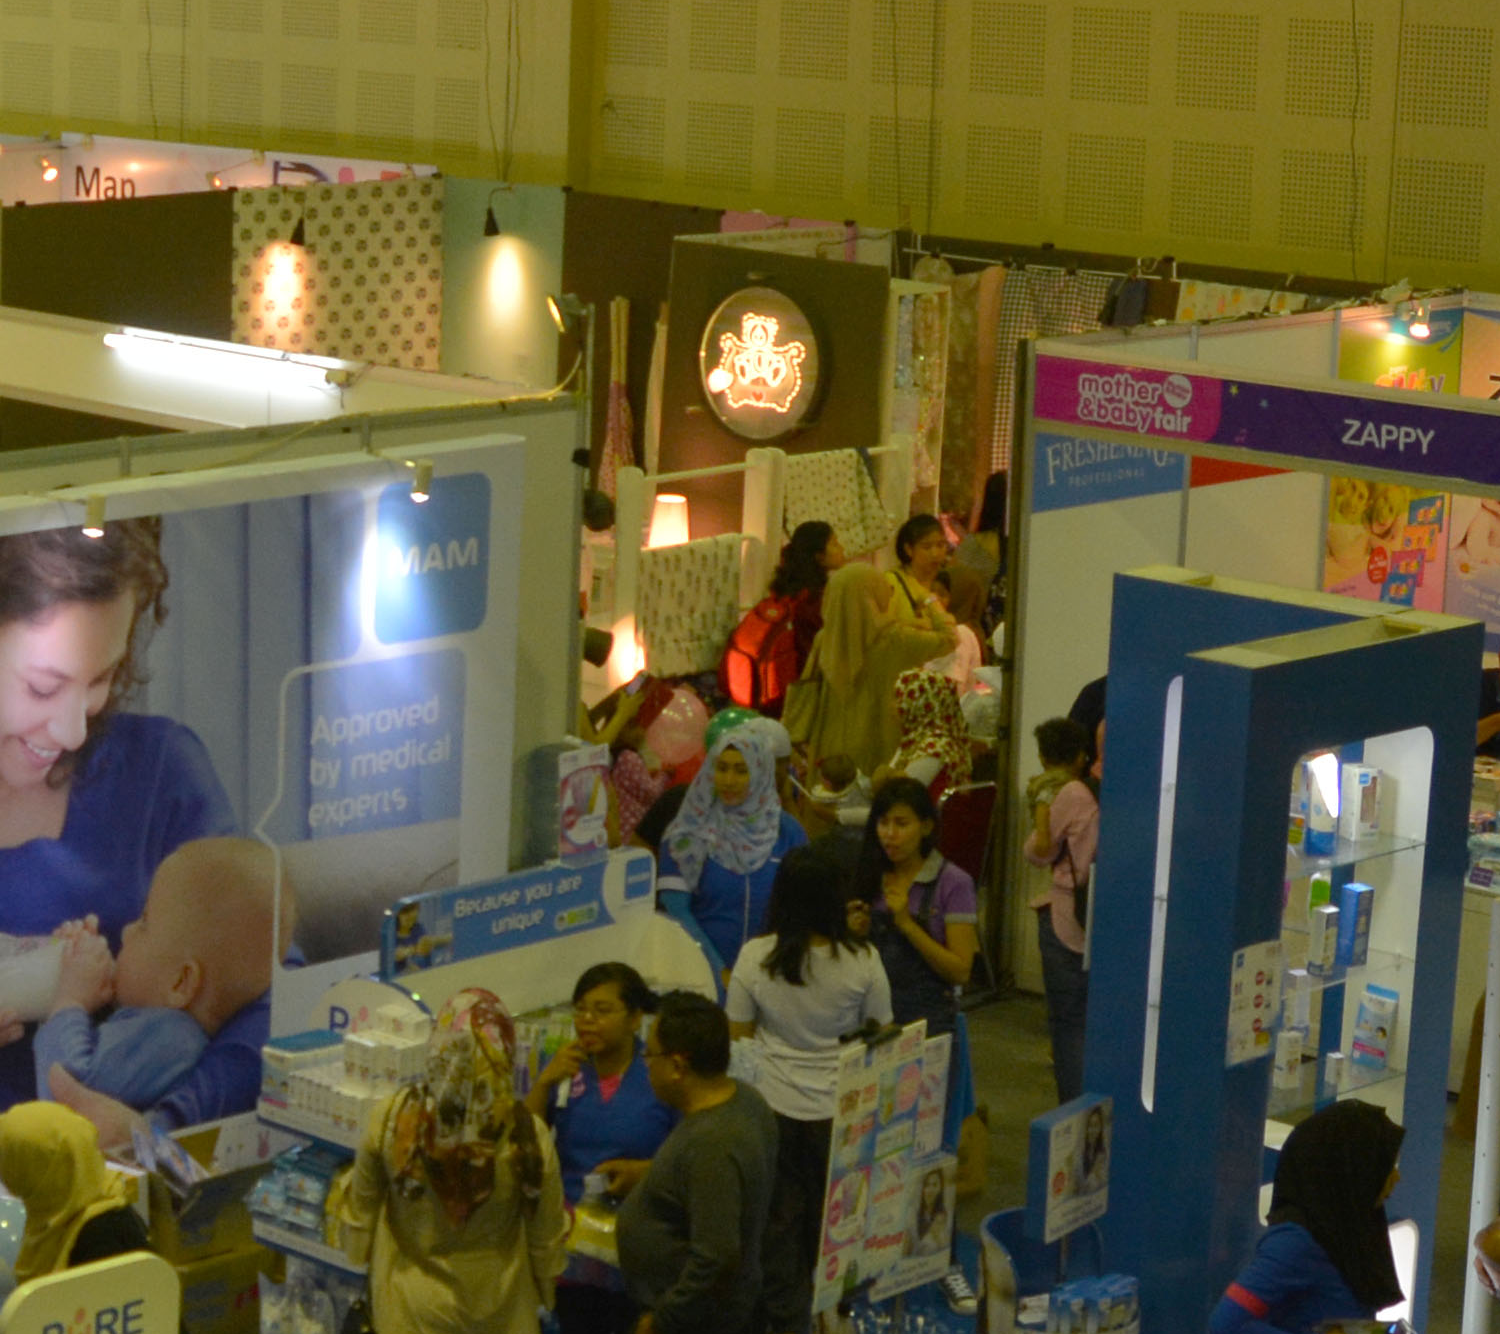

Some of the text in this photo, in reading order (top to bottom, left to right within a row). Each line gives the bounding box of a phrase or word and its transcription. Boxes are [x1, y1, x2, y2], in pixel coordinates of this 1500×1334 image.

[74, 163, 137, 201] Map
[1077, 371, 1162, 405] mother
[1078, 395, 1193, 434] &baby fair
[1342, 418, 1436, 456] ZAPPY
[388, 536, 480, 577] MAM
[310, 695, 440, 746] Approved
[308, 735, 452, 788] by medical
[308, 787, 408, 830] experts
[453, 875, 583, 918] Because you are
[491, 908, 546, 936] unique
